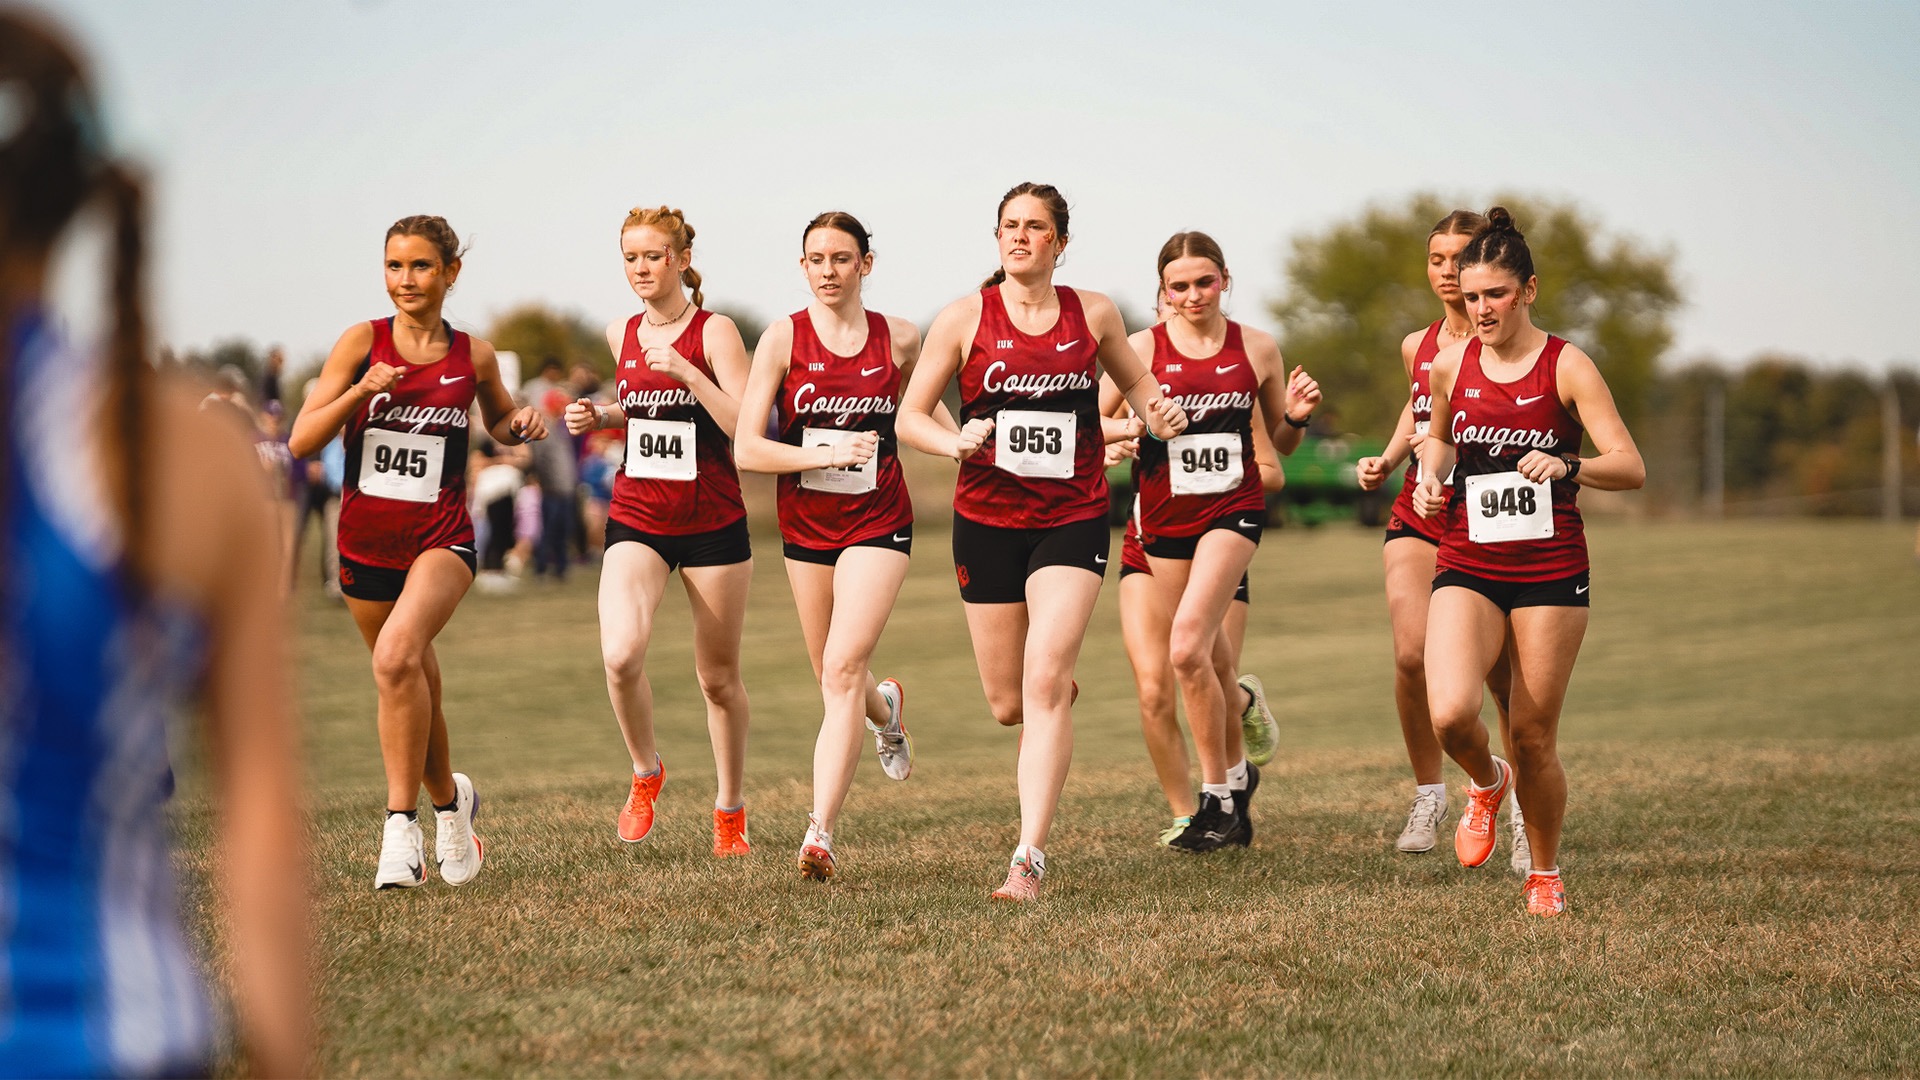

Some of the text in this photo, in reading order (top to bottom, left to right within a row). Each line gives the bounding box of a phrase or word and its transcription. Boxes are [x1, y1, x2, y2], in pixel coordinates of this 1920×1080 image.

[997, 340, 1013, 349] IUK
[808, 363, 825, 372] IUK
[983, 360, 1092, 400] Cougars
[1165, 364, 1182, 373] IUK
[794, 383, 895, 426] Cougars
[1465, 388, 1480, 398] IUK
[368, 392, 469, 435] Cougars
[639, 433, 684, 459] 944
[1009, 425, 1063, 455] 953
[1451, 410, 1559, 457] Cougars
[374, 444, 428, 478] 945
[1181, 447, 1230, 473] 949
[1480, 485, 1537, 518] 948
